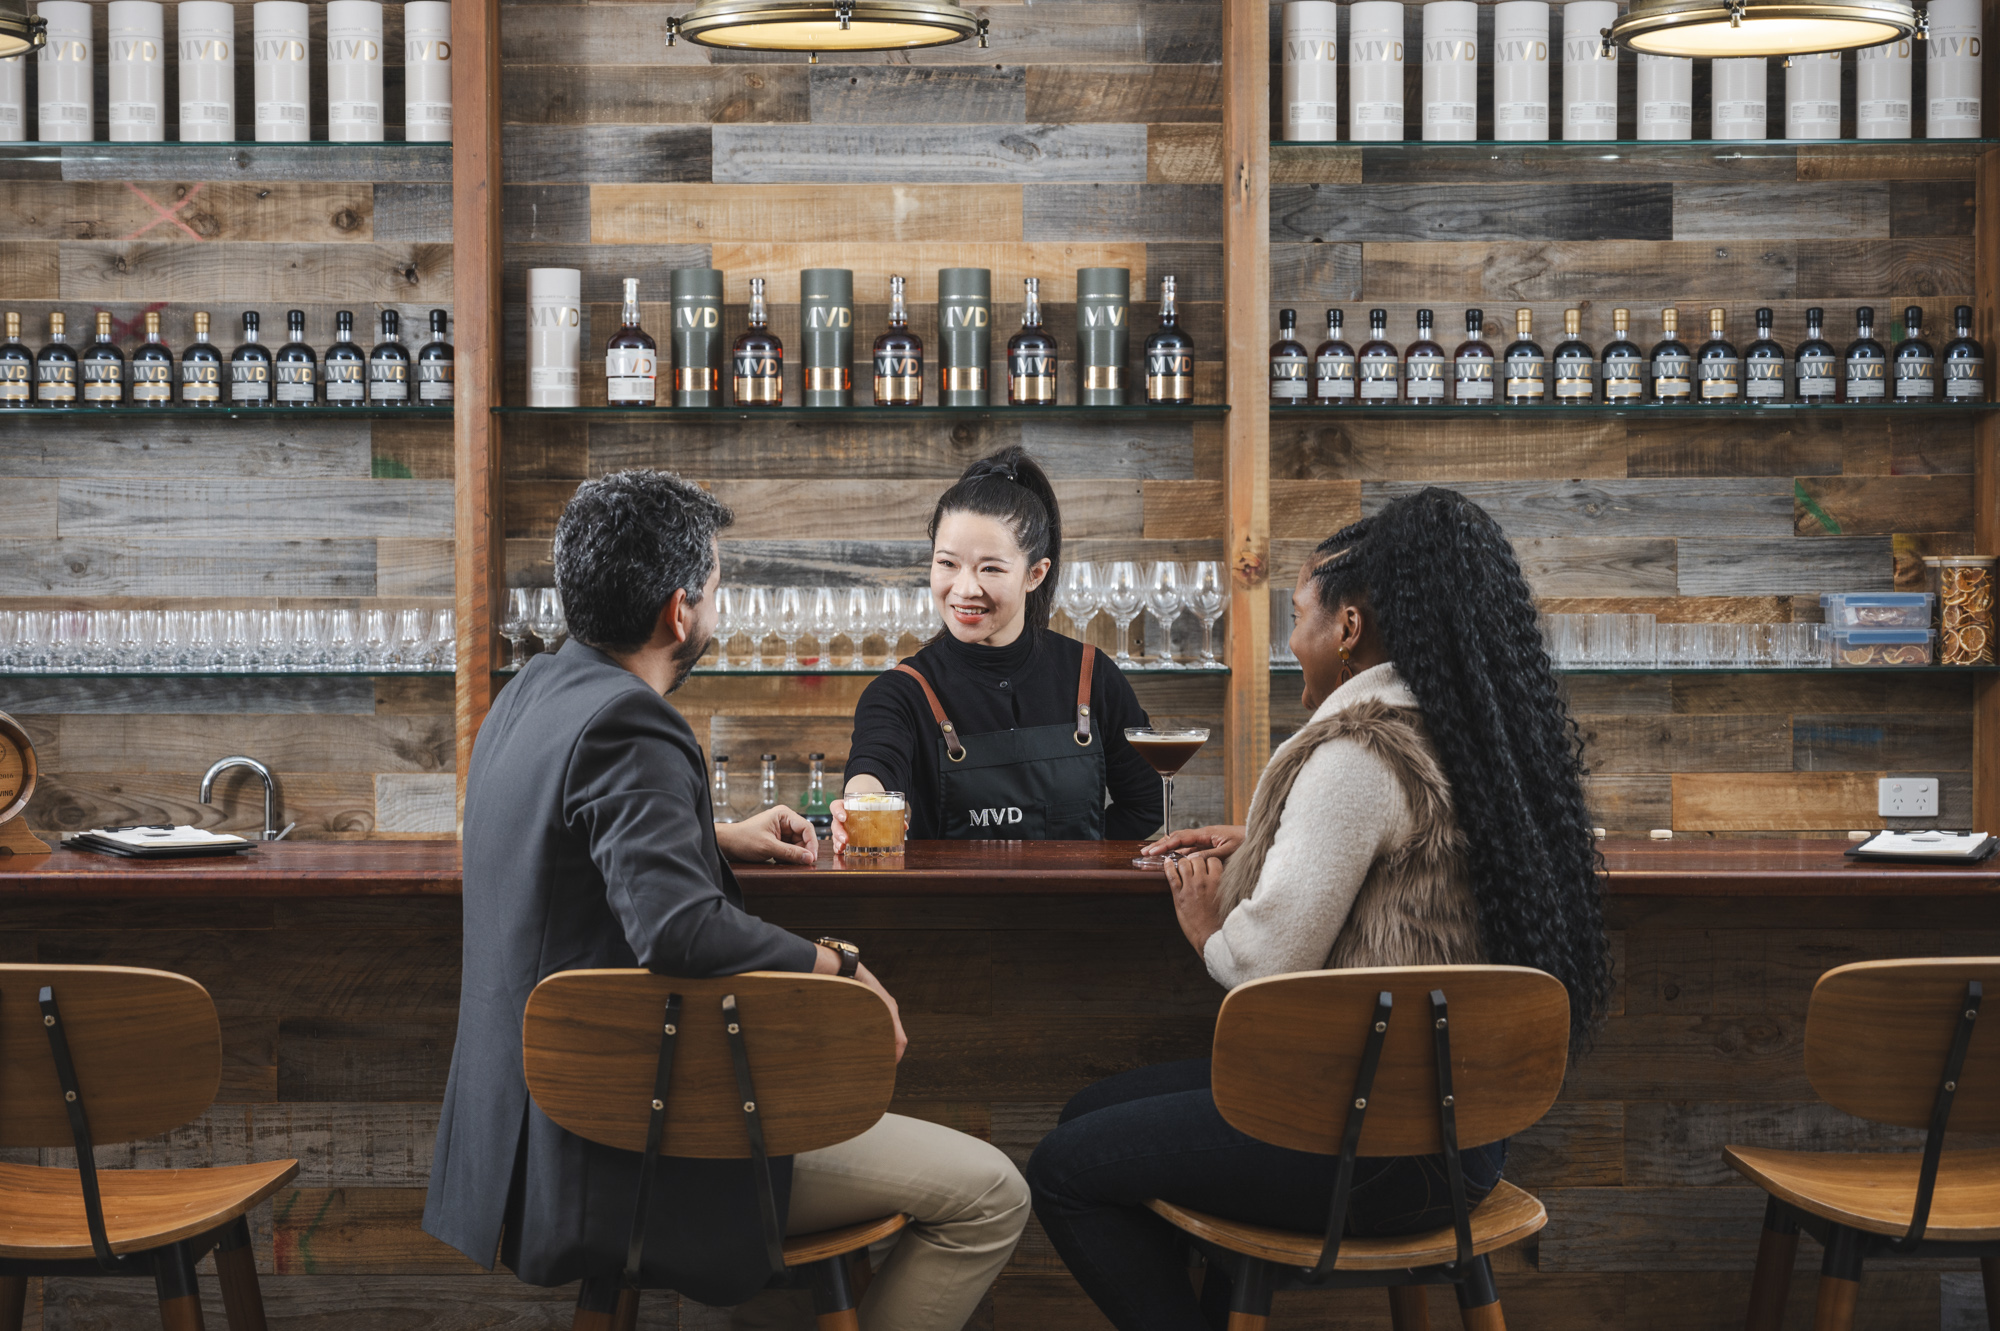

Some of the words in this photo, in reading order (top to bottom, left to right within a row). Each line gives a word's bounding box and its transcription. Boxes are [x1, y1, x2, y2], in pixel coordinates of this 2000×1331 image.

[179, 40, 229, 61] MVD
[255, 40, 305, 62] MVD
[329, 40, 379, 61] MVD
[1288, 40, 1336, 62] MVD
[1354, 40, 1403, 62] MVD
[1426, 40, 1476, 63] MVD
[1497, 40, 1547, 63] MVD
[1567, 40, 1617, 62] MV
[1929, 37, 1981, 59] MVD
[529, 306, 579, 327] MVD
[805, 306, 852, 328] MVD
[940, 306, 989, 328] MVD
[85, 365, 120, 379] MVD
[611, 358, 652, 374] MVD
[736, 358, 778, 375] MVD
[877, 358, 919, 375] MVD
[1016, 357, 1056, 374] MVD
[1150, 356, 1192, 373] MVD
[1273, 363, 1307, 377] MVD
[1319, 363, 1353, 377] MVD
[1363, 363, 1397, 377] MVD
[1410, 363, 1443, 377] MVD
[1458, 363, 1492, 377] MVD
[1510, 363, 1543, 377] MVD
[1558, 363, 1592, 377] MVD
[1609, 363, 1641, 377] MVD
[1705, 364, 1737, 378] MVD
[1749, 364, 1784, 378] MVD
[1849, 364, 1884, 378] MVD
[1900, 363, 1933, 377] MVD
[1950, 364, 1983, 378] MVD
[39, 366, 75, 380] MVD
[133, 366, 168, 380] MVD
[183, 366, 218, 380] MVD
[232, 366, 267, 380] MVD
[277, 367, 313, 382] MVD
[327, 366, 362, 380] MVD
[371, 365, 406, 380] MVD
[968, 807, 1023, 826] MVD
